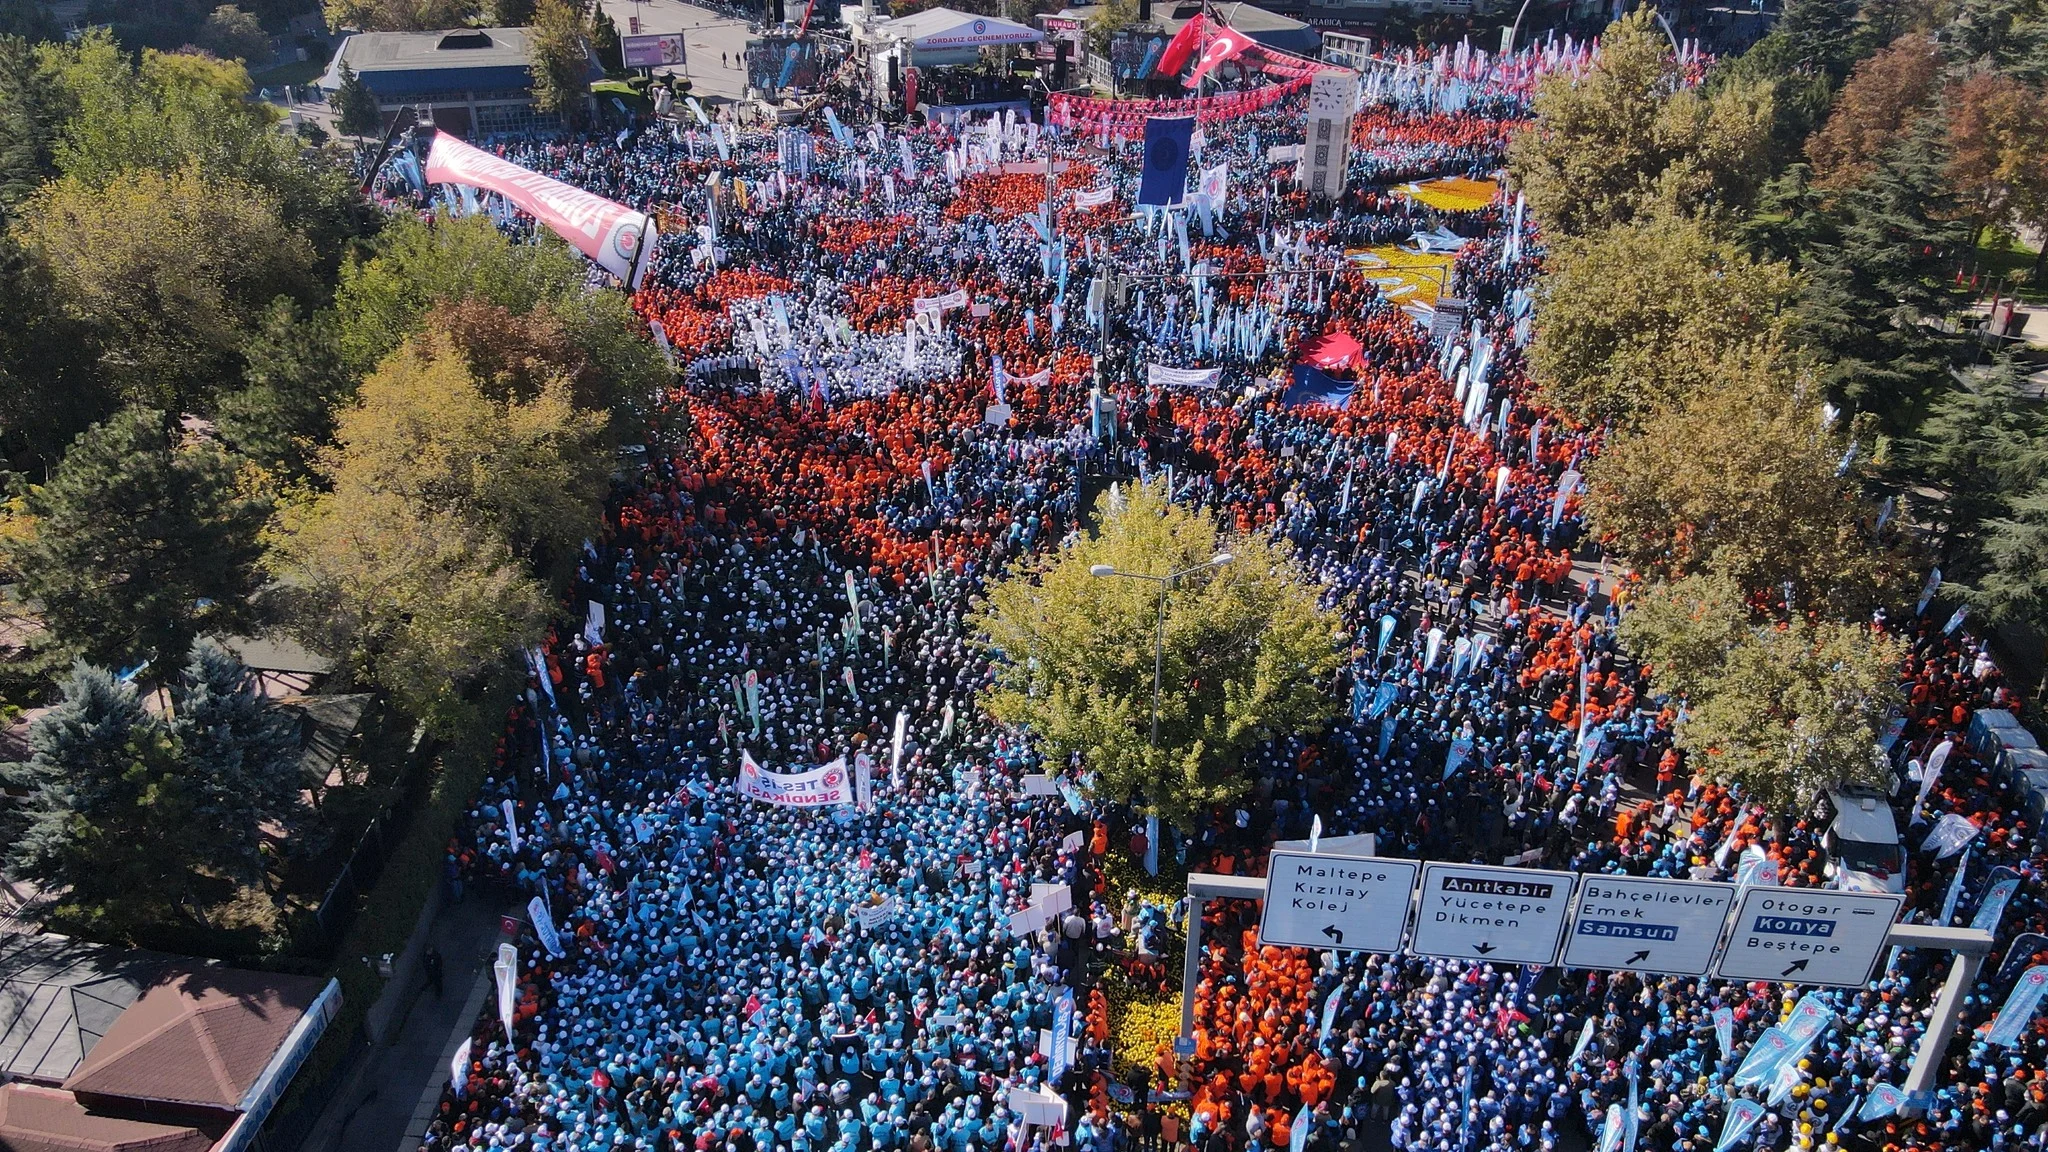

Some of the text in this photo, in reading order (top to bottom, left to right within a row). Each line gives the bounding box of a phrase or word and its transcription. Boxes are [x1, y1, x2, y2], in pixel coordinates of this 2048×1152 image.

[1046, 20, 1076, 29] AUHAUS
[1307, 18, 1342, 27] ARABICA
[926, 37, 965, 45] ZORDAYIZ
[1297, 864, 1388, 883] Maltepe
[1294, 881, 1369, 899] Kızılay
[1445, 877, 1551, 898] Anıtkabir
[1292, 898, 1348, 913] Kolej
[1440, 895, 1547, 915] Yücetepe
[1588, 886, 1724, 908] Bahçelievler
[1583, 904, 1644, 919] Emek
[1761, 898, 1842, 916] Otogar
[1435, 911, 1519, 928] Dikmen
[1757, 917, 1830, 936] Konya
[1581, 921, 1675, 940] Samsun
[1746, 937, 1841, 955] Beştepe
